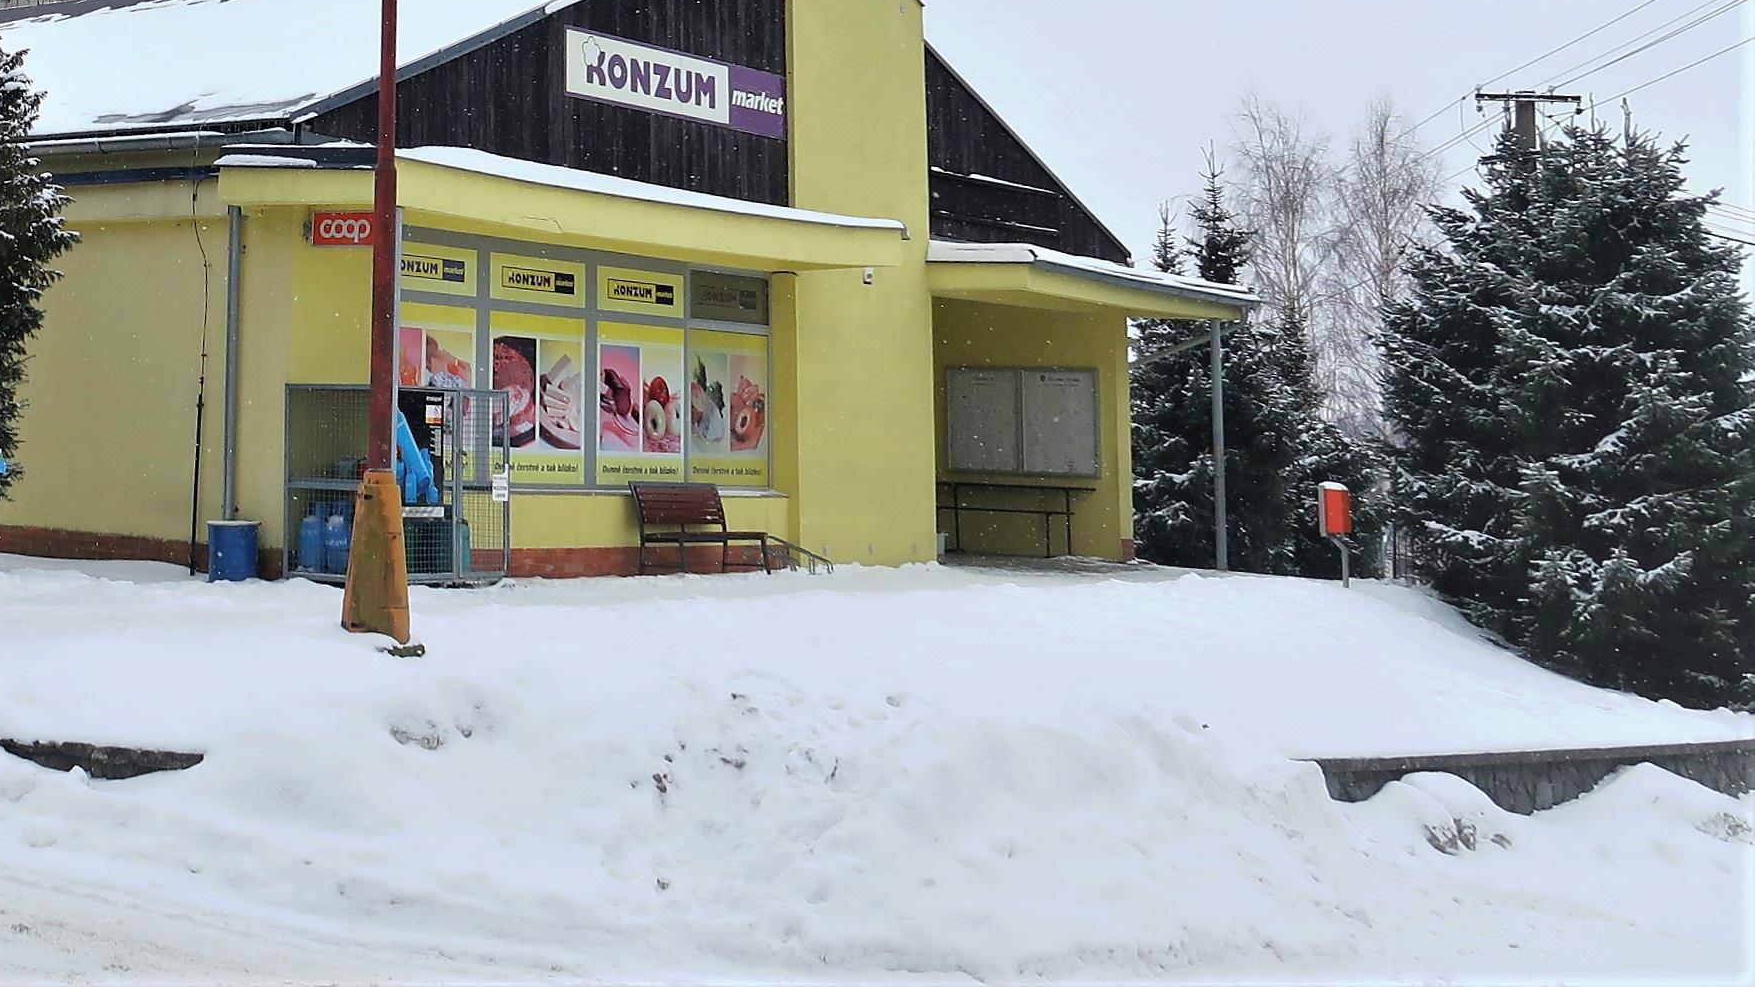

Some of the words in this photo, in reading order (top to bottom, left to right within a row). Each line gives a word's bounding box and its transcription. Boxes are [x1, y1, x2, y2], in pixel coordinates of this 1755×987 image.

[586, 51, 716, 109] KONZUM
[732, 89, 784, 115] market
[319, 219, 371, 243] coop
[401, 259, 438, 274] ONZUM
[508, 272, 551, 287] KONZUM
[613, 285, 652, 299] KONZUM
